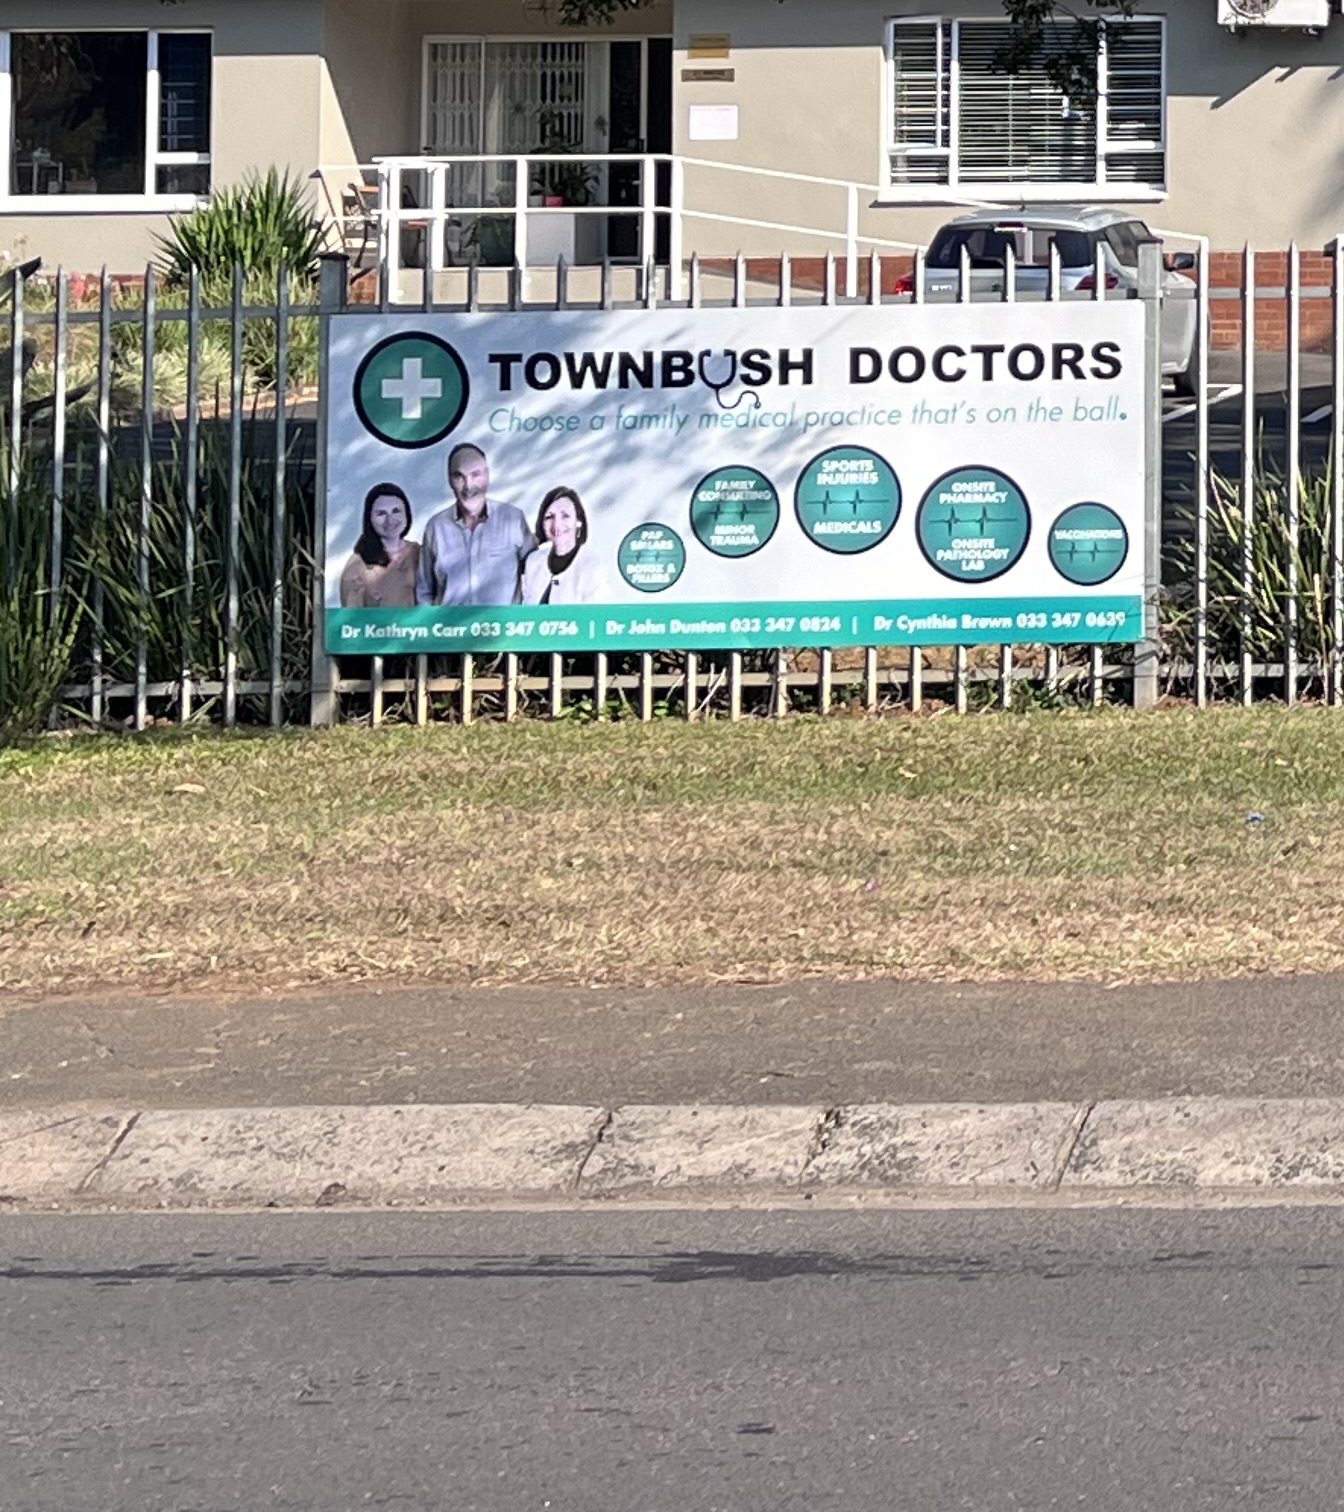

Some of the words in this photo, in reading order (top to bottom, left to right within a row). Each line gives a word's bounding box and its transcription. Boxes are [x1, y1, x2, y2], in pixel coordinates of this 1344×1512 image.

[488, 347, 814, 394] TOWNBUSH
[849, 341, 1123, 385] DOCTORS
[488, 406, 580, 432] Choose
[588, 416, 606, 432] a
[615, 405, 690, 435] family
[698, 402, 797, 431] medical
[802, 401, 903, 432] practice
[910, 397, 977, 425] that's
[986, 404, 1017, 423] on
[1026, 396, 1064, 423] the
[821, 459, 875, 473] SPORTS
[816, 472, 879, 486] INJURIES
[951, 481, 996, 493] ONSITE
[939, 491, 1009, 505] PHARMACY
[714, 524, 756, 535] MINOR
[813, 520, 882, 535] MEDICALS
[709, 535, 760, 546] TRAUMA
[951, 538, 995, 549] ONSITE
[936, 548, 1011, 561] PATHOLOGY
[961, 559, 986, 572] LAB
[341, 624, 361, 639] Dr
[364, 623, 429, 642] Kathryn
[431, 624, 467, 638] Carr
[470, 622, 501, 637] 033
[505, 621, 536, 637] 347
[538, 621, 579, 636] 0756
[605, 620, 626, 635] Dr
[628, 619, 666, 635] John
[730, 618, 761, 633] 033
[765, 617, 796, 633] 347
[800, 616, 841, 632] 0824
[873, 616, 893, 631] Dr
[896, 614, 957, 634] Cynthia
[961, 614, 1013, 630] Brown
[1016, 612, 1048, 629] 033
[1051, 611, 1082, 628] 347
[1085, 611, 1127, 627] 0639
